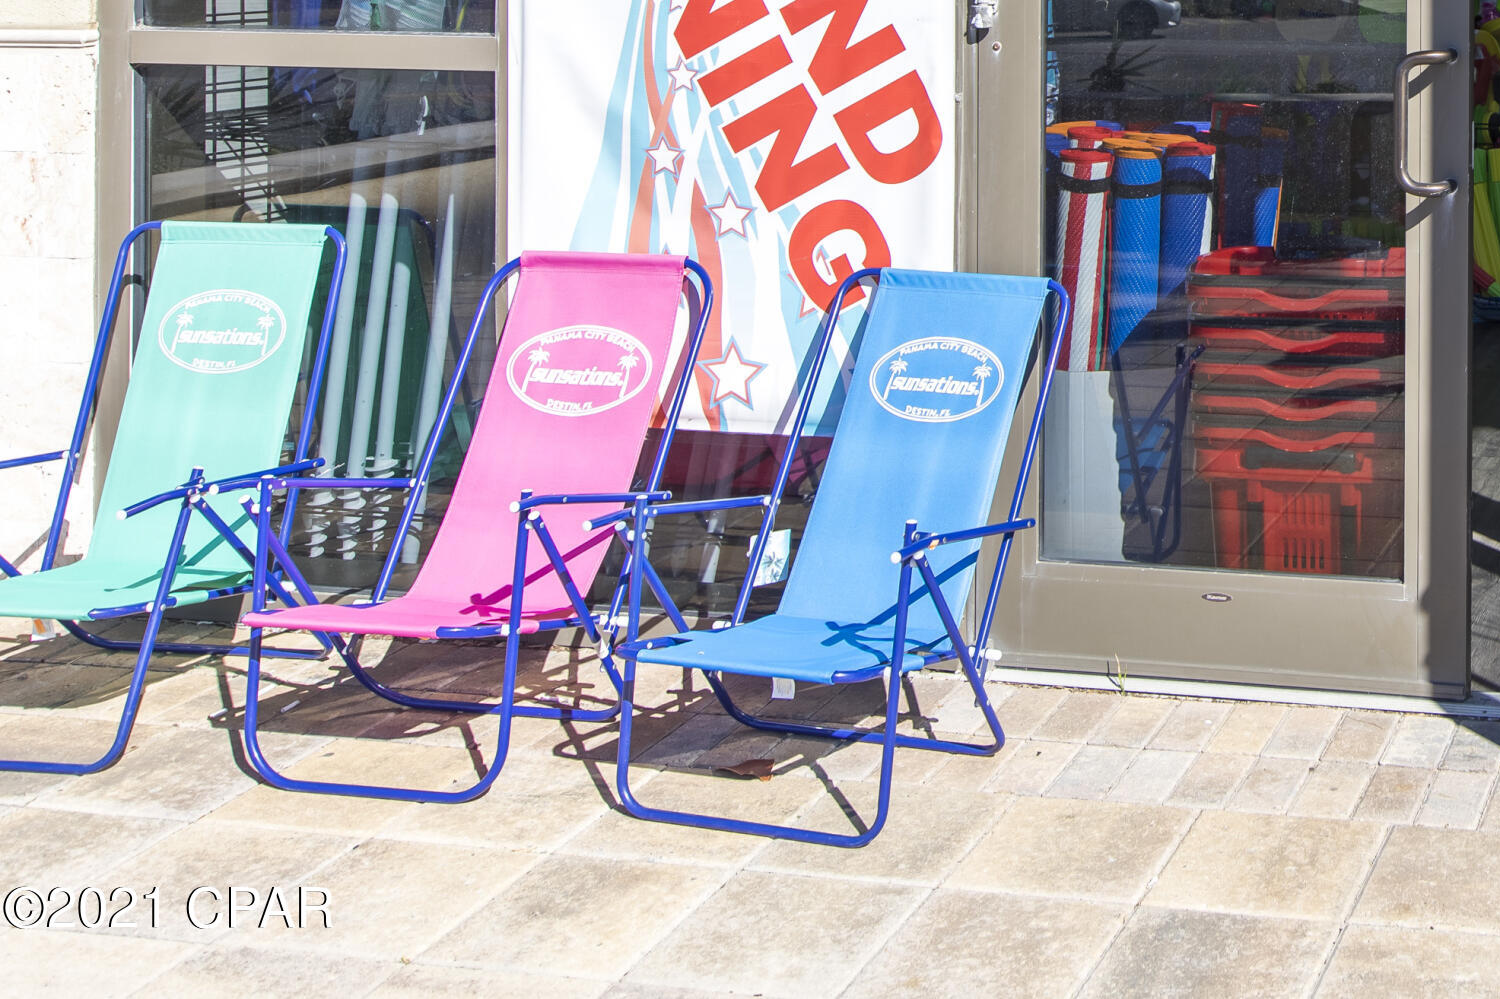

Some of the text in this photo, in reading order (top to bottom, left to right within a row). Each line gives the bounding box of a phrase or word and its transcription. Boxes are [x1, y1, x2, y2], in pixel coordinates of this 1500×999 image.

[224, 295, 244, 303] CITY
[244, 295, 271, 314] BEACH
[541, 330, 636, 352] PANAMA CITY BEACH
[900, 341, 989, 364] PANAMA CITY BEACH
